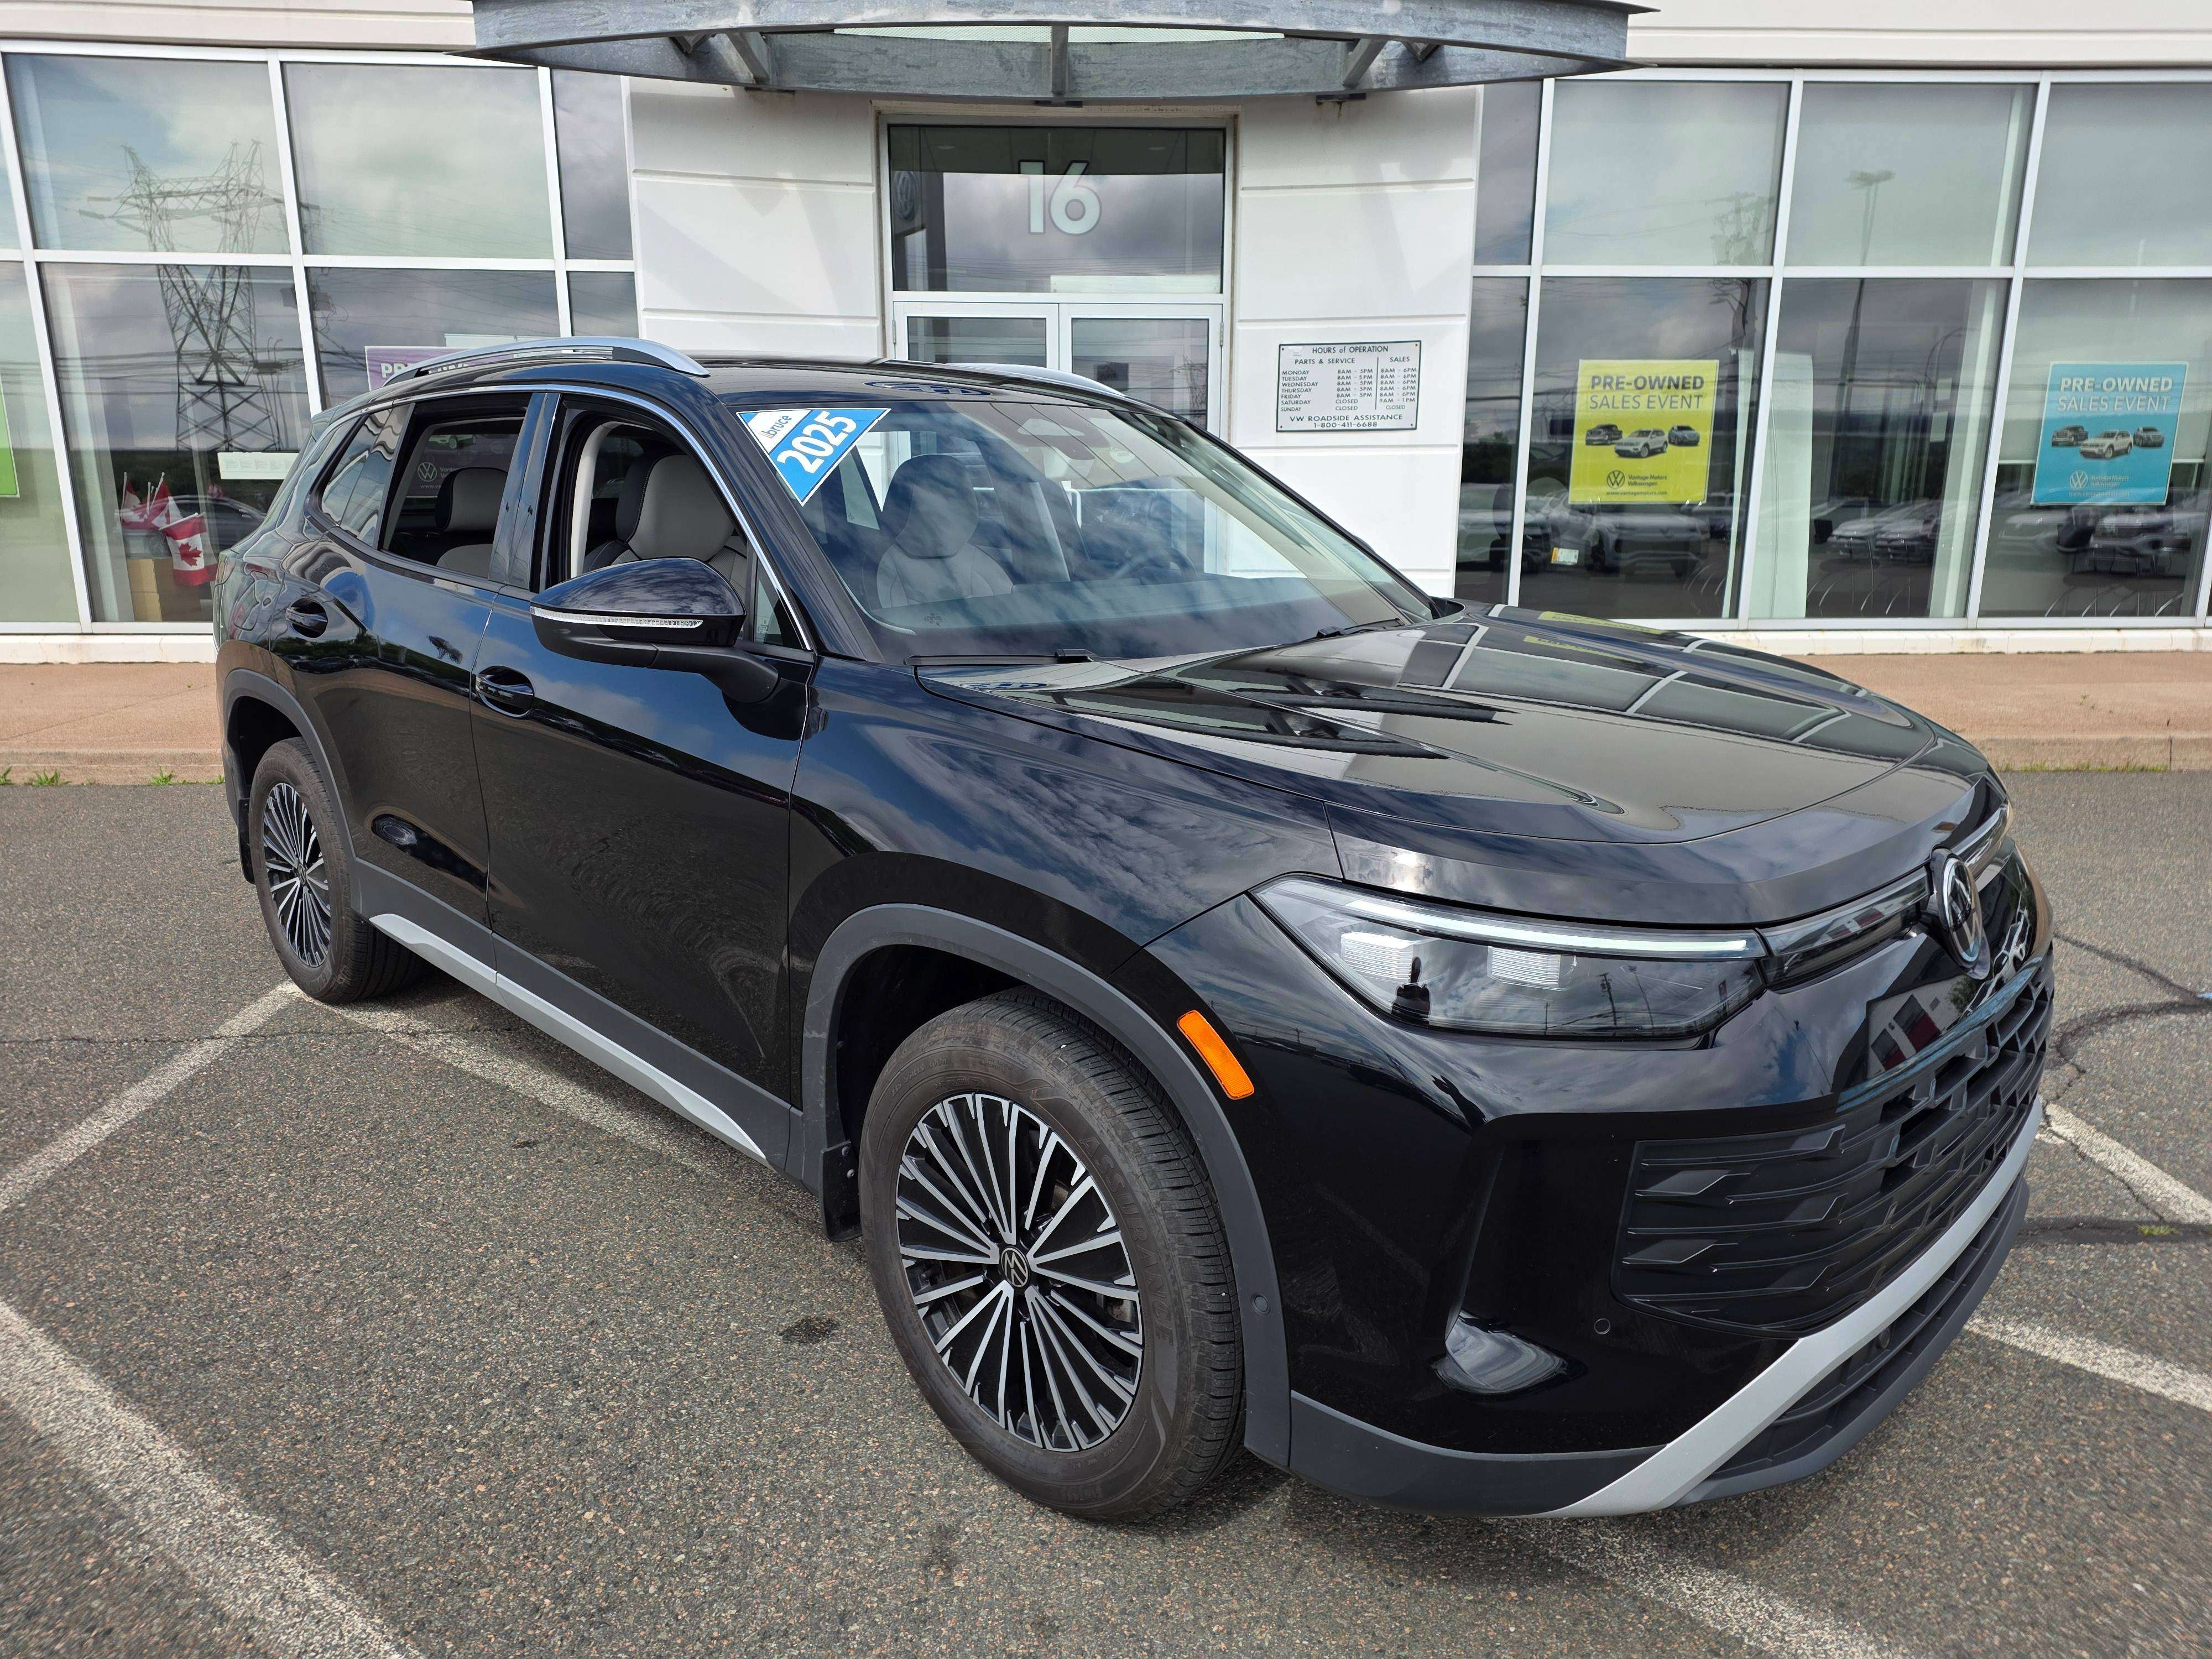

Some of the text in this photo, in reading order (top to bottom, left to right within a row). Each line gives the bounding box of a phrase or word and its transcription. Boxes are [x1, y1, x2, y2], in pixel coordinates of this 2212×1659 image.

[1018, 160, 1102, 236] 16
[1590, 375, 1704, 390] PRE-OWNED
[2060, 377, 2173, 393] PRE-OWNED
[1589, 395, 1704, 410] SALES EVENT
[2058, 395, 2171, 412] SALES EVENT
[759, 415, 792, 436] bruce
[776, 410, 857, 474] 2025
